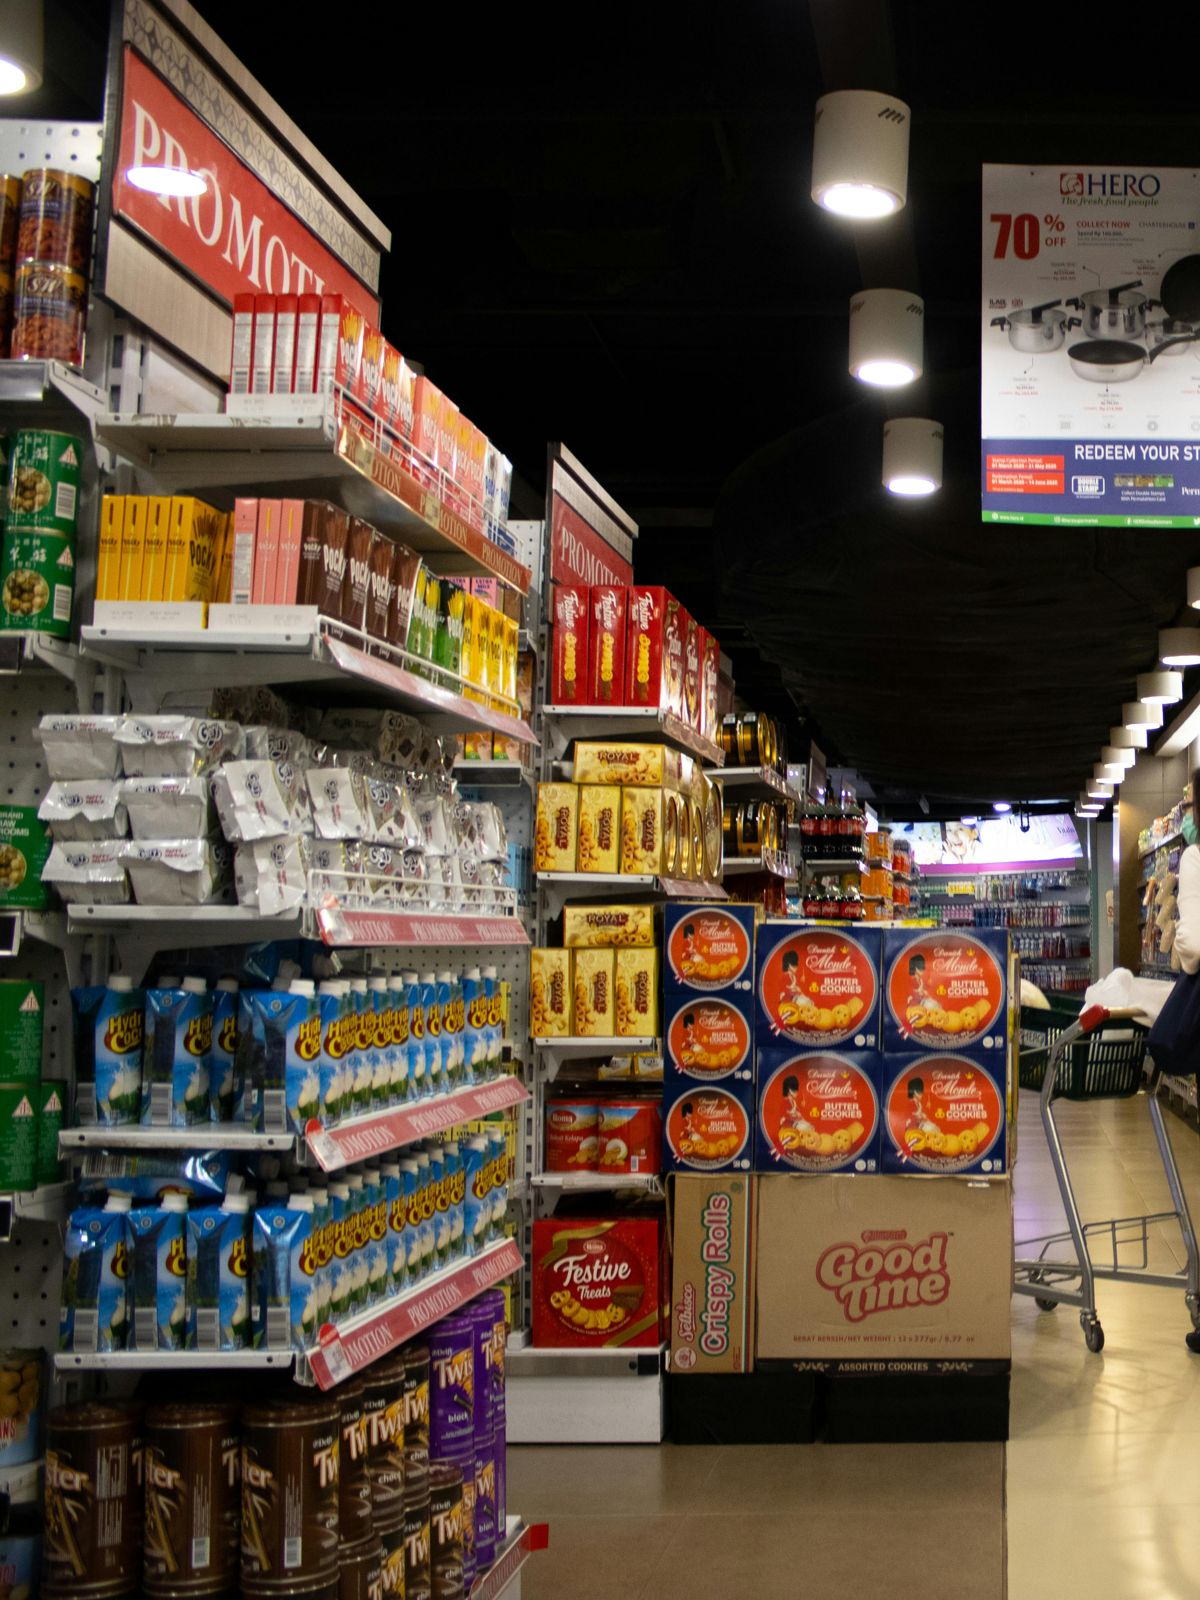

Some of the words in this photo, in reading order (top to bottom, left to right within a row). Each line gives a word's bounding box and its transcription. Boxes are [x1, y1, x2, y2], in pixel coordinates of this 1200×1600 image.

[1088, 173, 1161, 198] HERO
[1062, 197, 1078, 205] The
[1080, 197, 1103, 207] fresh
[1105, 197, 1126, 207] food
[1129, 198, 1159, 208] people
[1076, 220, 1109, 229] COLLECT
[1111, 221, 1131, 229] NOW
[990, 213, 1040, 261] 70
[1044, 214, 1065, 232] %
[1045, 237, 1067, 248] OFF
[1074, 445, 1136, 461] REDEEM
[1139, 446, 1180, 461] YOUR
[482, 543, 523, 584] PROMOTION
[598, 751, 637, 762] ROYAL
[558, 809, 570, 850] ROYAL
[602, 809, 613, 850] ROYAL
[645, 810, 656, 852] ROYAL
[587, 914, 627, 925] ROYAL
[805, 955, 857, 975] Monde
[932, 957, 984, 977] Monde
[820, 985, 862, 994] COOKIES
[824, 977, 859, 986] BUTTER
[947, 987, 989, 996] COOKIES
[951, 979, 986, 988] BUTTER
[553, 972, 564, 1014] ROYAL
[597, 972, 608, 1014] ROYAL
[638, 972, 649, 1014] ROYAL
[806, 1080, 857, 1100] Monde
[930, 1080, 982, 1101] Monde
[408, 1102, 466, 1134] PROMOTION
[474, 1083, 523, 1112] PROMOTION
[820, 1110, 862, 1119] COOKIES
[824, 1102, 859, 1110] BUTTER
[946, 1110, 988, 1119] COOKIES
[949, 1103, 984, 1111] BUTTER
[702, 1193, 731, 1261] Rolls
[553, 1253, 631, 1288] Festive
[818, 1233, 946, 1289] Good
[408, 1282, 463, 1328] PROMOTION
[472, 1248, 517, 1288] PROMOTION
[577, 1284, 612, 1301] Treats
[701, 1266, 734, 1355] Crispy
[837, 1361, 886, 1373] ASSORTED
[888, 1362, 928, 1373] COOKIES
